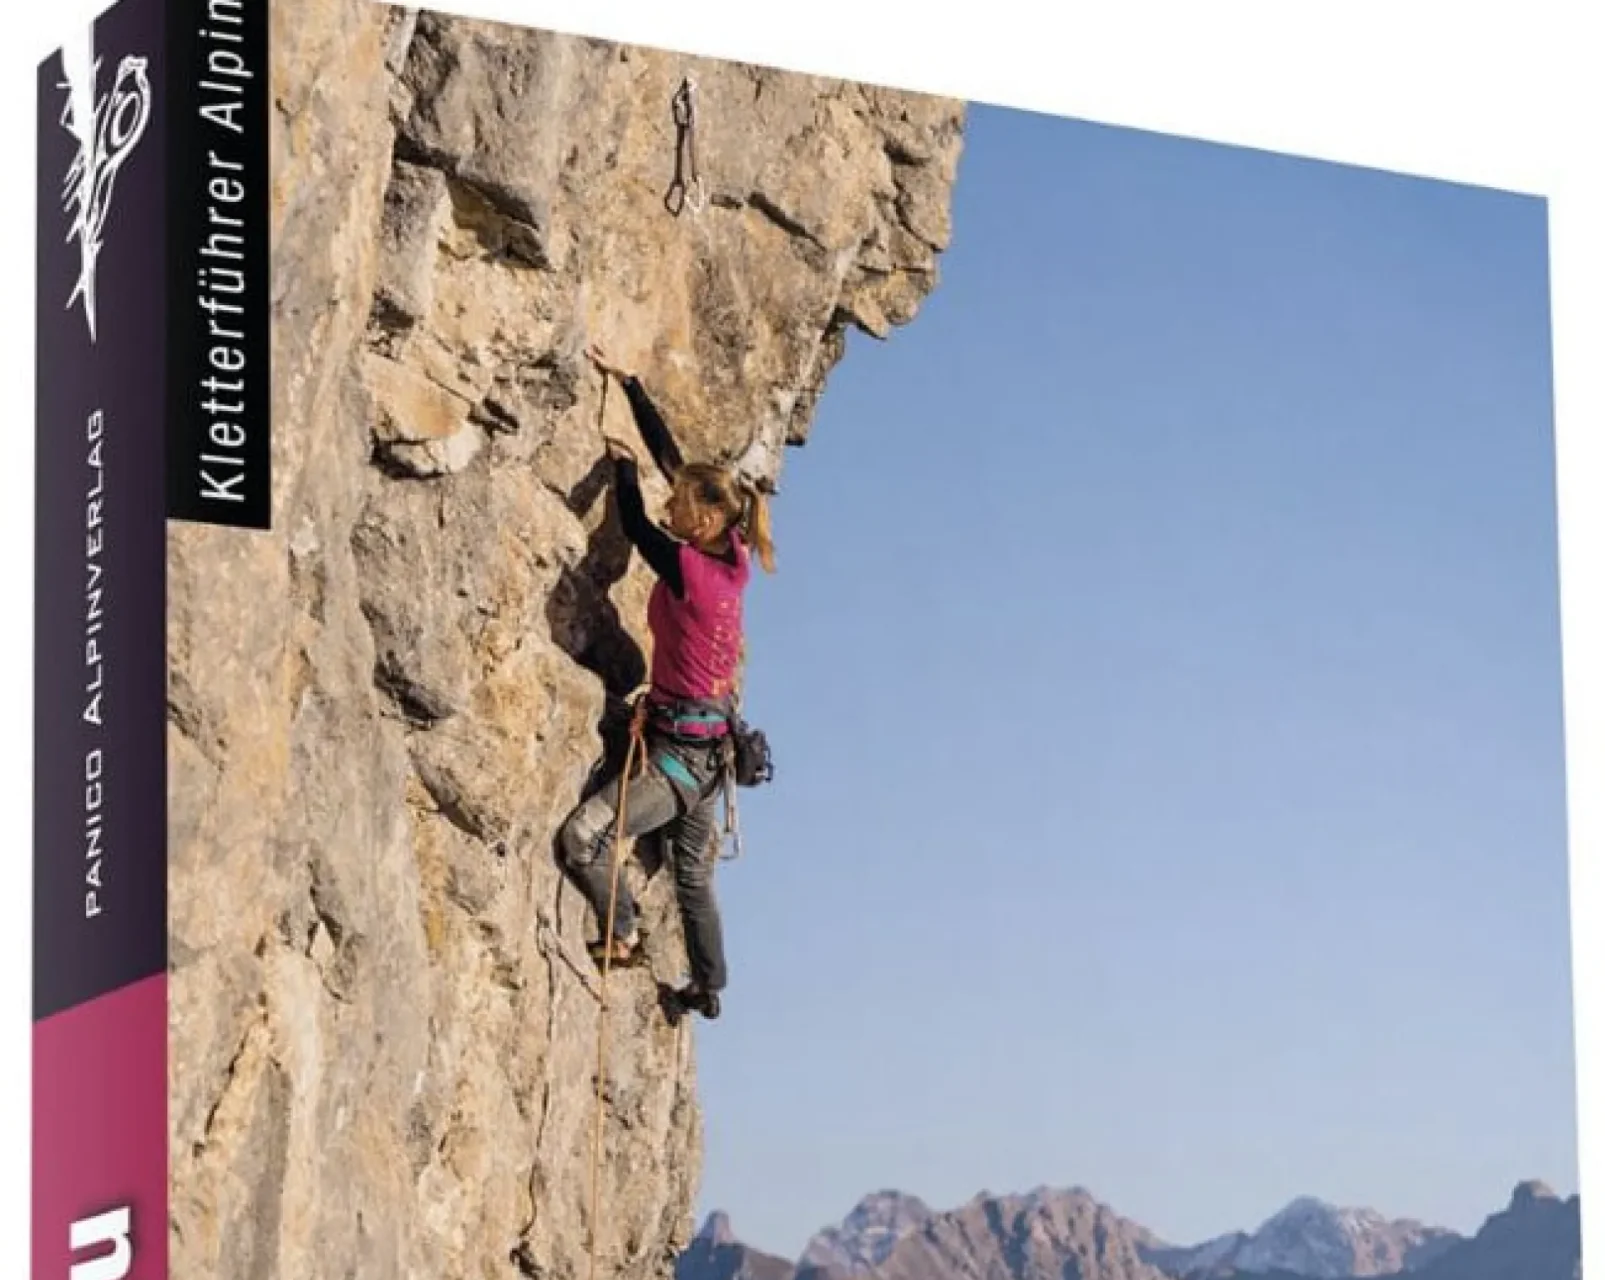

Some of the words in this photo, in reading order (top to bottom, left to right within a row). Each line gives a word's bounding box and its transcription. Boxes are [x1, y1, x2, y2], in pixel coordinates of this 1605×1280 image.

[198, 0, 254, 133] Alpin
[198, 150, 245, 502] Kletterführer
[83, 408, 103, 725] ALPINVERLAG
[85, 749, 102, 918] PANICO
